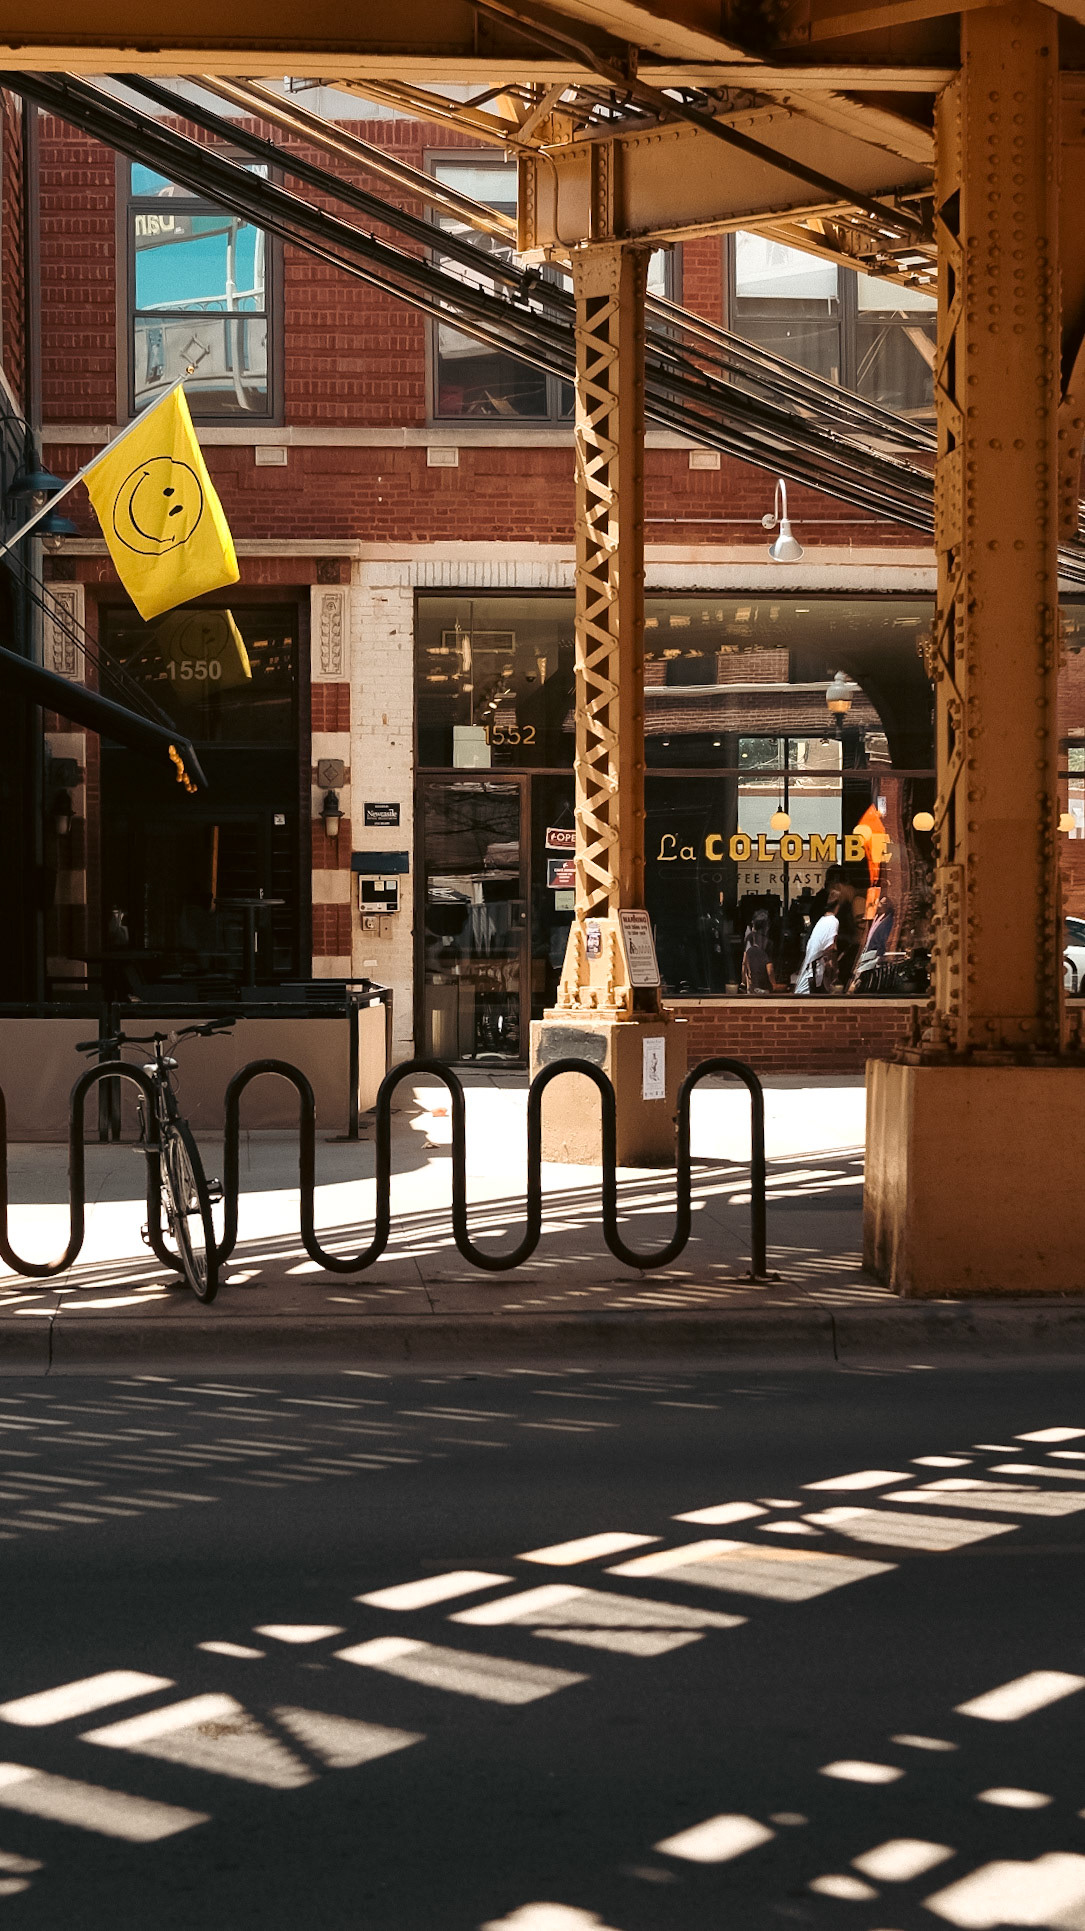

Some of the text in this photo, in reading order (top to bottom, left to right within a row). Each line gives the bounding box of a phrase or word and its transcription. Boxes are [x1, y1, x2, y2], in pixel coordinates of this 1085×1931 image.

[166, 660, 222, 680] 1550
[483, 725, 536, 745] 1552
[556, 832, 577, 842] OPE
[657, 833, 893, 864] La COLOMBE
